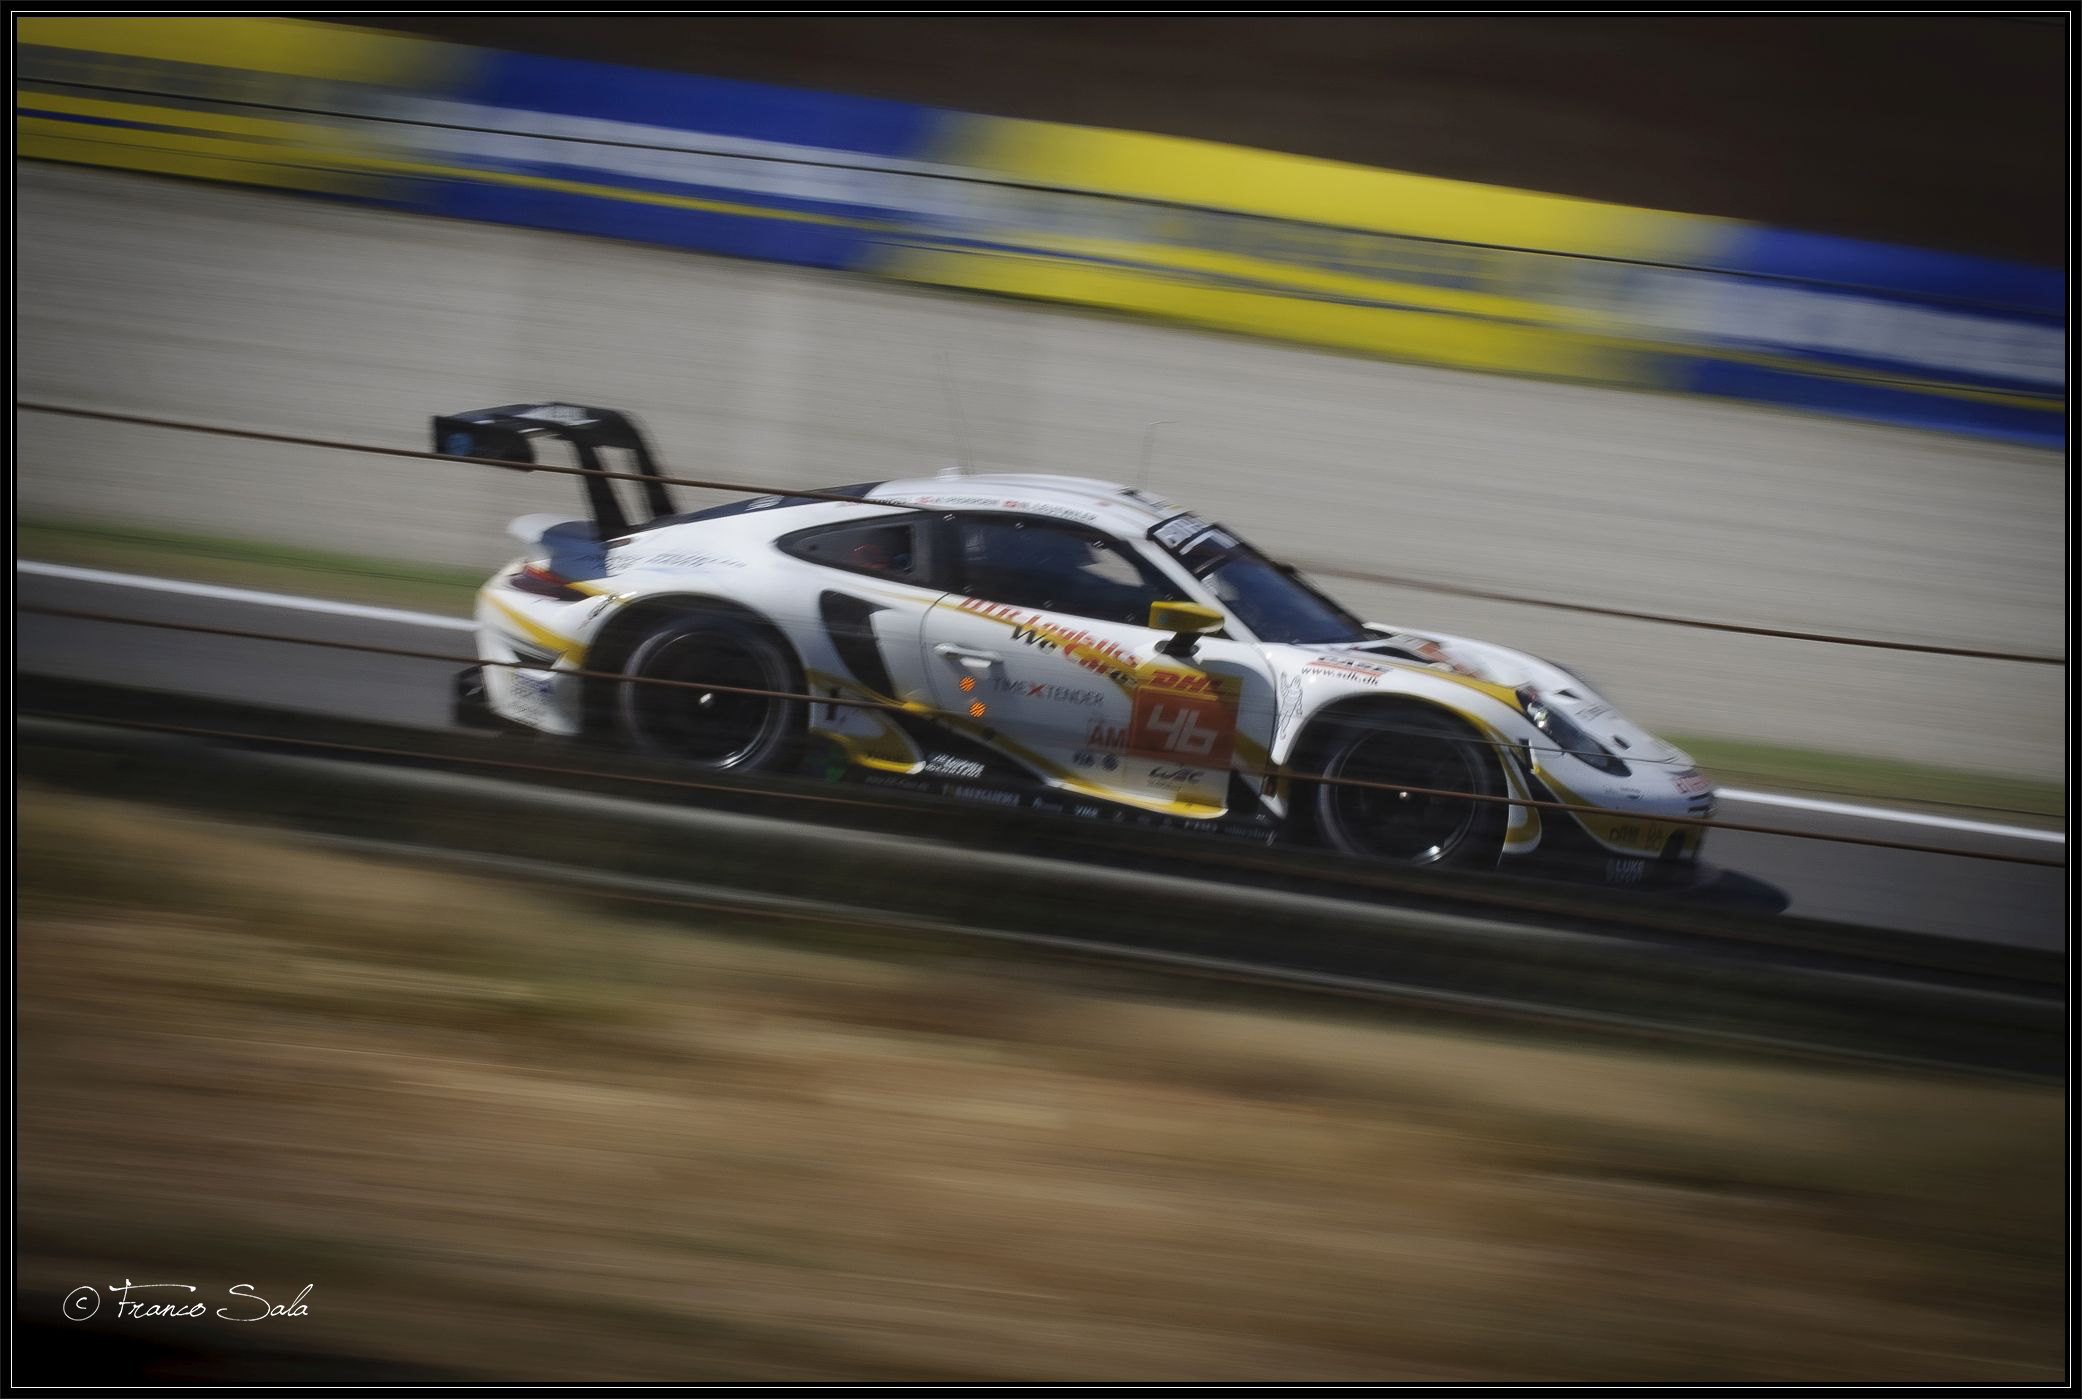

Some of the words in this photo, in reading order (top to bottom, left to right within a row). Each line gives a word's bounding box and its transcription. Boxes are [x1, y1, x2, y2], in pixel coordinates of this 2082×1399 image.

[1010, 625, 1058, 654] We
[1150, 670, 1224, 695] DHL
[1087, 724, 1130, 751] AM
[1147, 703, 1219, 755] 46
